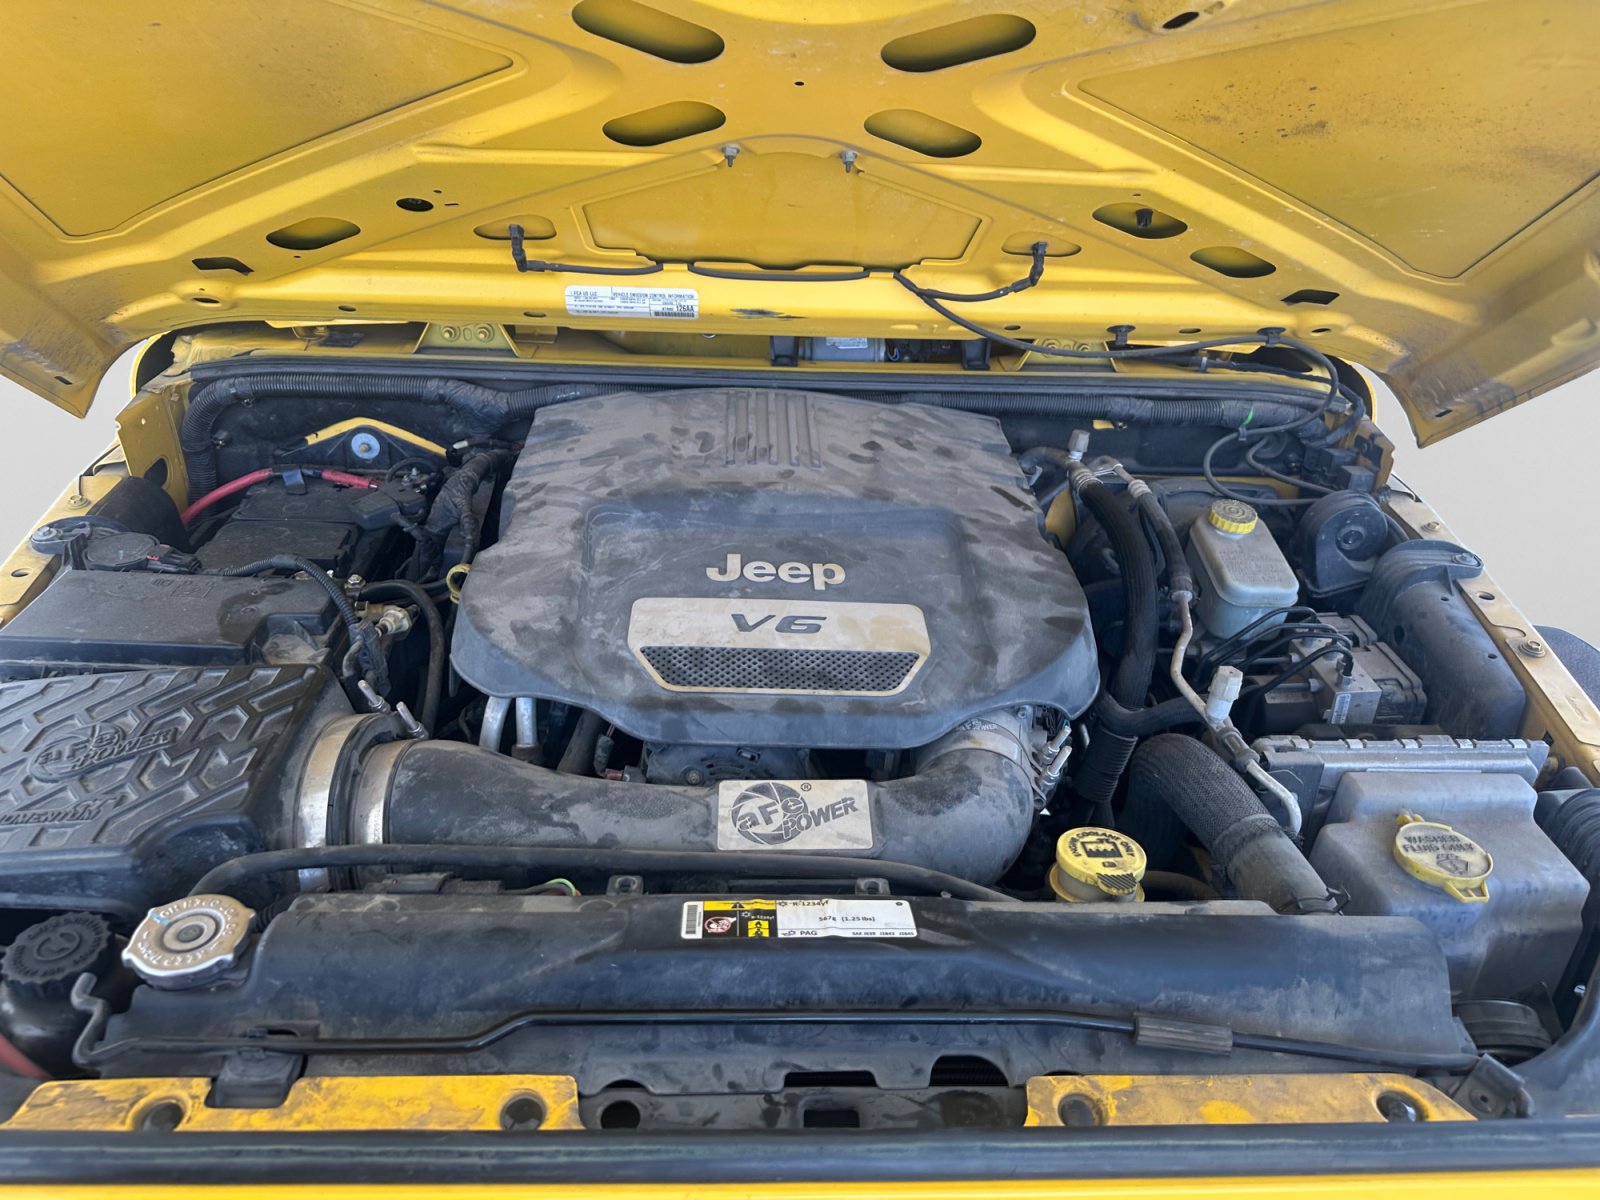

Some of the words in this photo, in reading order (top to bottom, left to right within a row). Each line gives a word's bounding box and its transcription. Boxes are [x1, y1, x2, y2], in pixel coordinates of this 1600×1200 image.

[705, 553, 846, 590] Jeep
[730, 613, 828, 634] V6
[737, 797, 804, 831] aFe
[782, 797, 858, 839] POWER
[1076, 831, 1121, 841] COOLANT
[1120, 841, 1135, 857] ONLY
